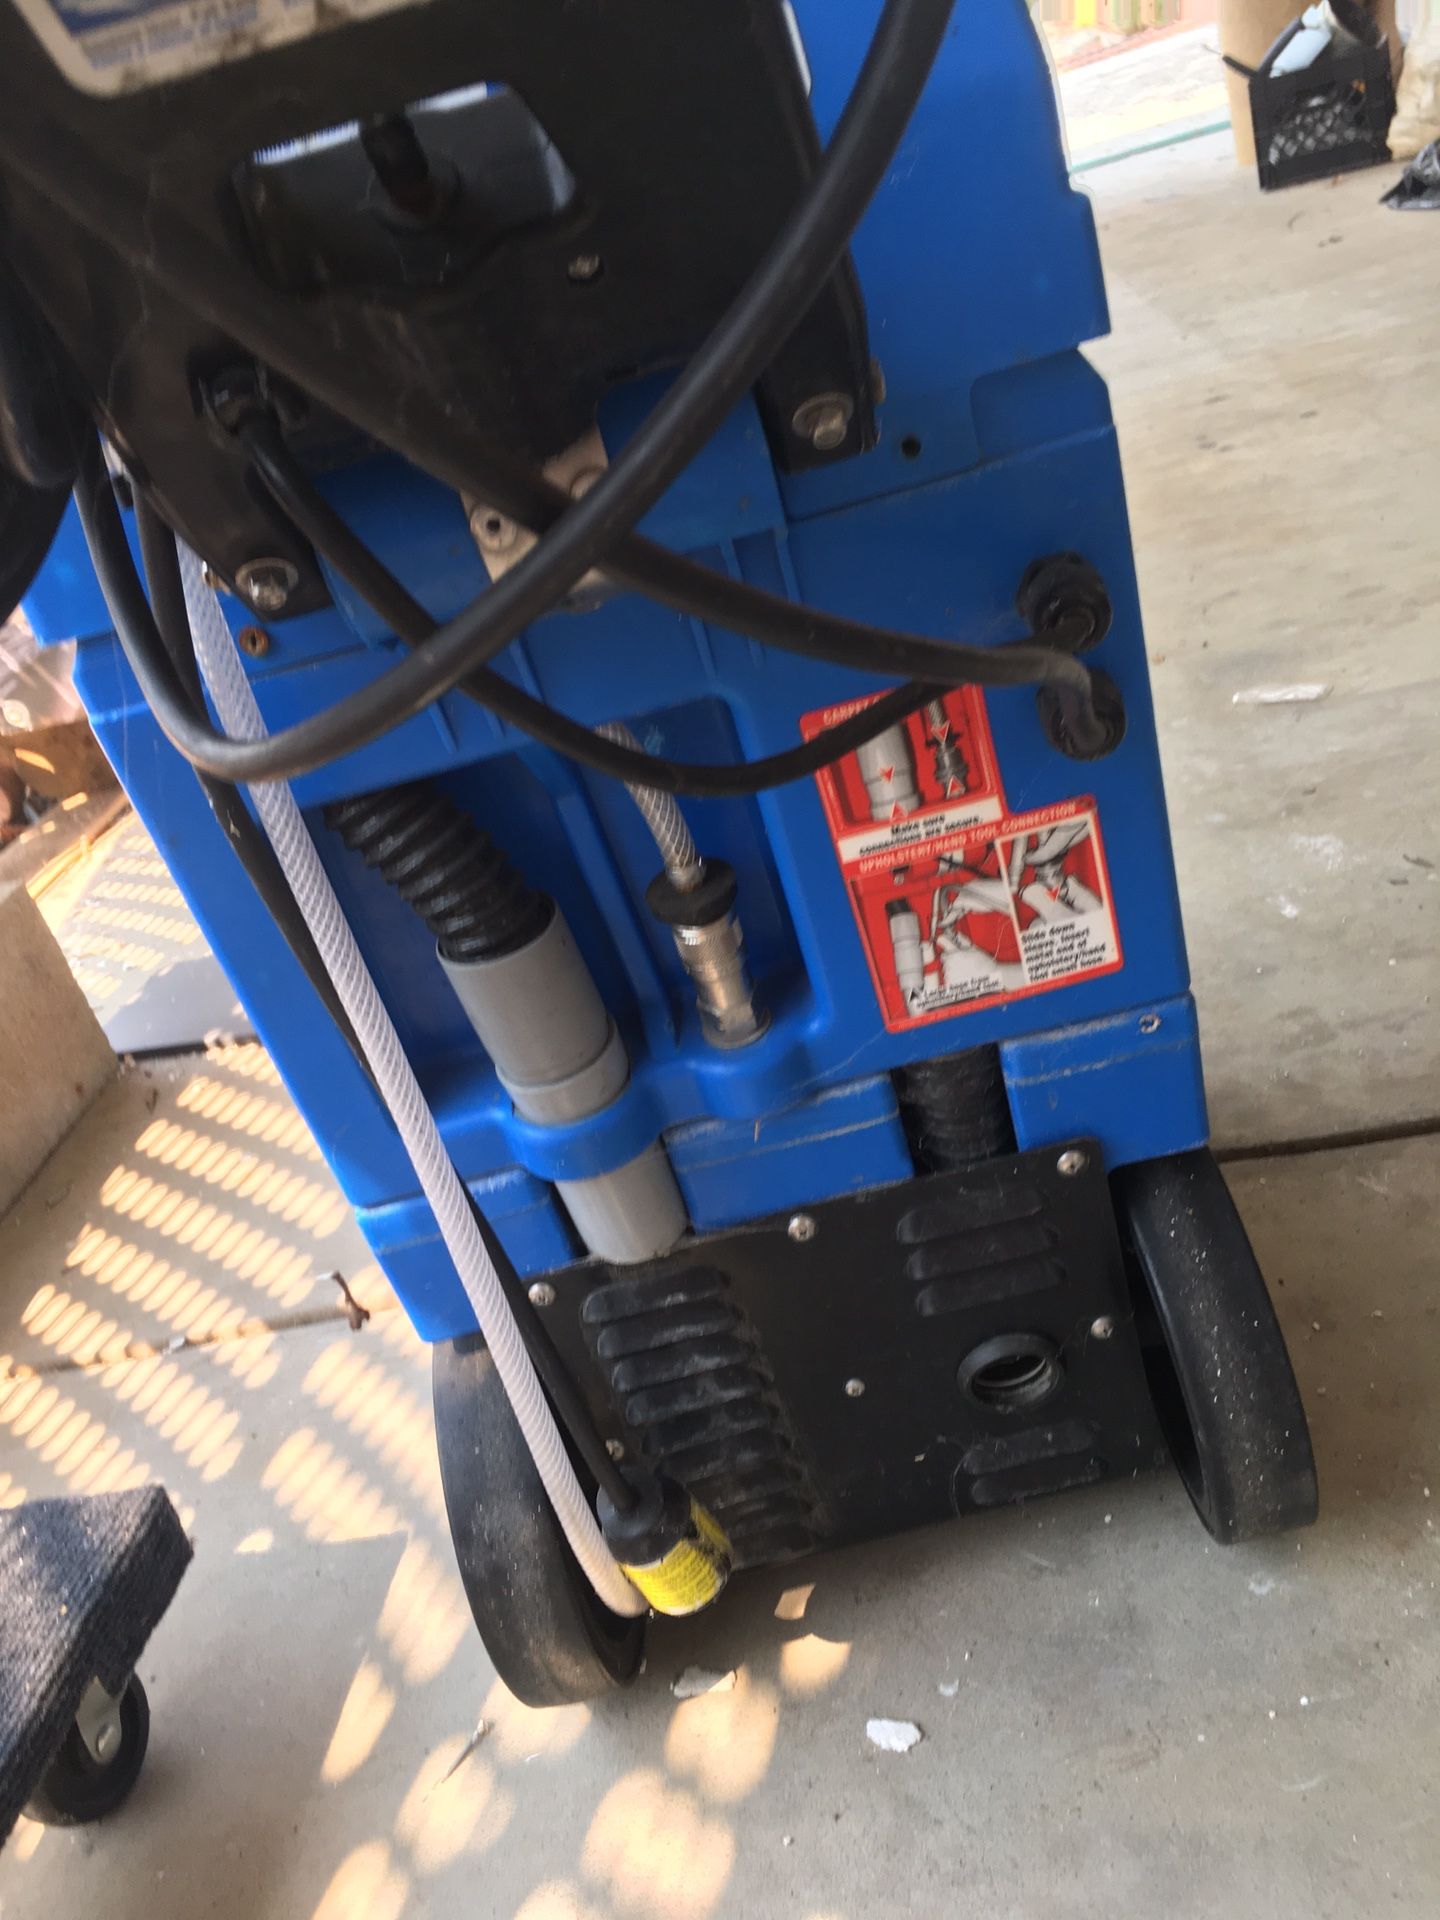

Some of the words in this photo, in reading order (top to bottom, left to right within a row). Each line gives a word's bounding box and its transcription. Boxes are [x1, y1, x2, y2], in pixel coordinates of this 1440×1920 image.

[971, 824, 997, 842] TOOL
[1001, 801, 1077, 833] CONNECTION
[1021, 930, 1046, 944] Slide
[1049, 922, 1075, 936] down
